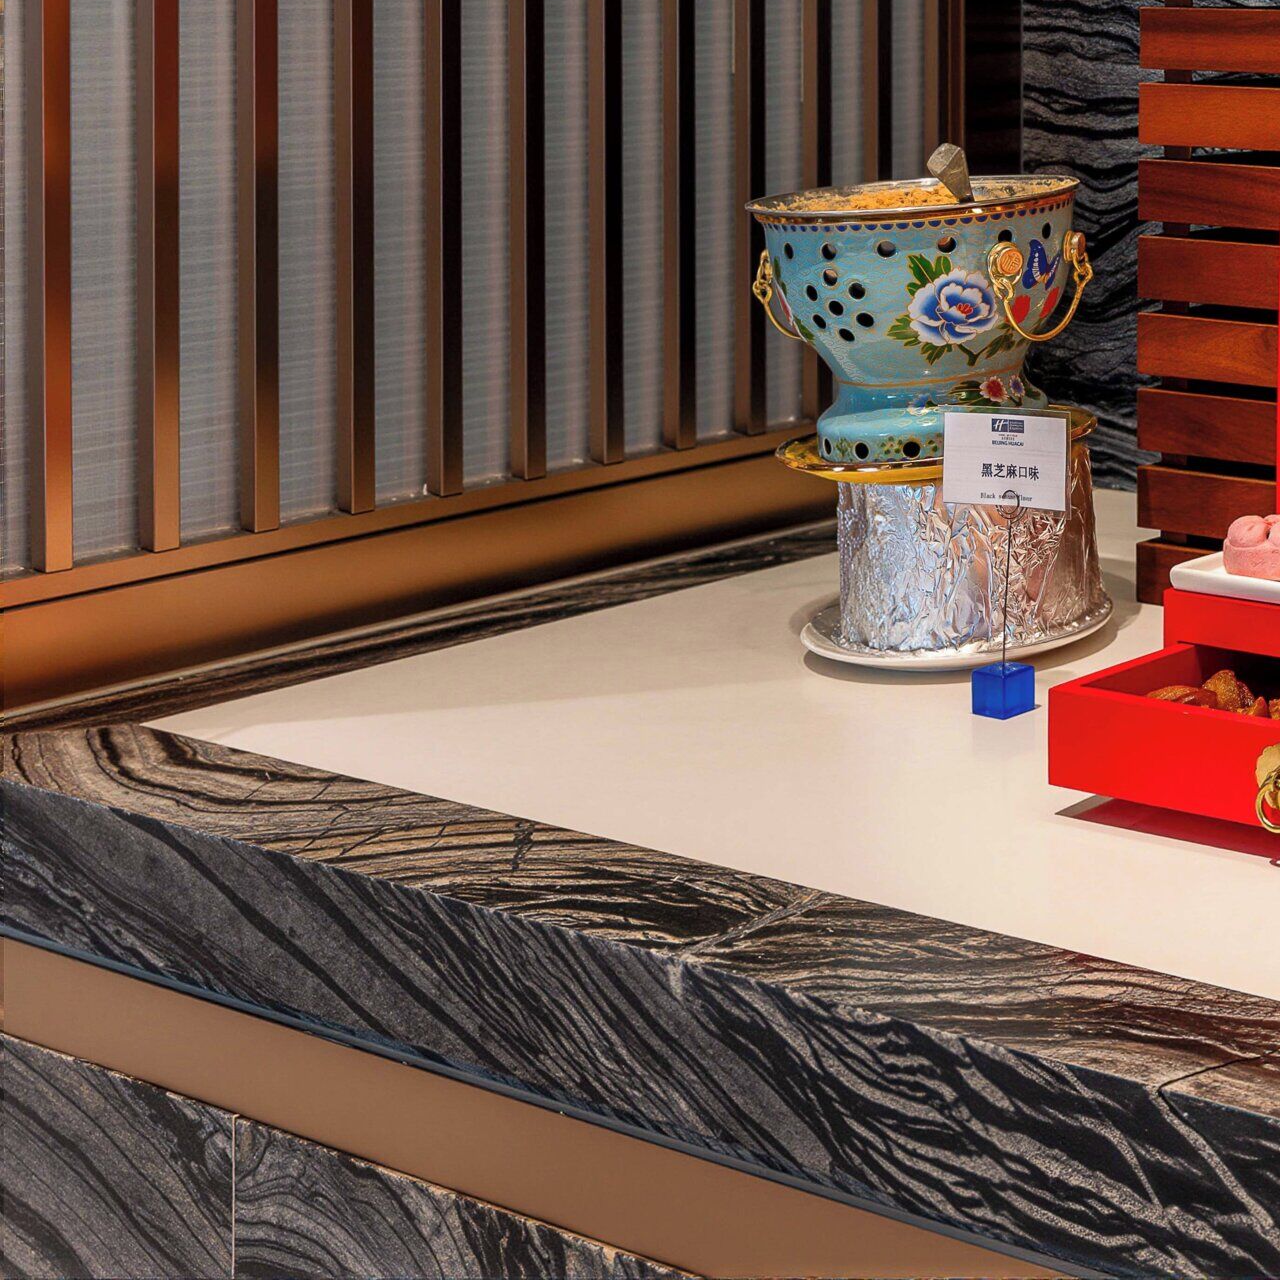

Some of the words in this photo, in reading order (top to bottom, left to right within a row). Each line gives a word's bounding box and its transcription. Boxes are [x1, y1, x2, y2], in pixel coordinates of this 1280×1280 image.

[981, 463, 1039, 480] 黑芝麻口味
